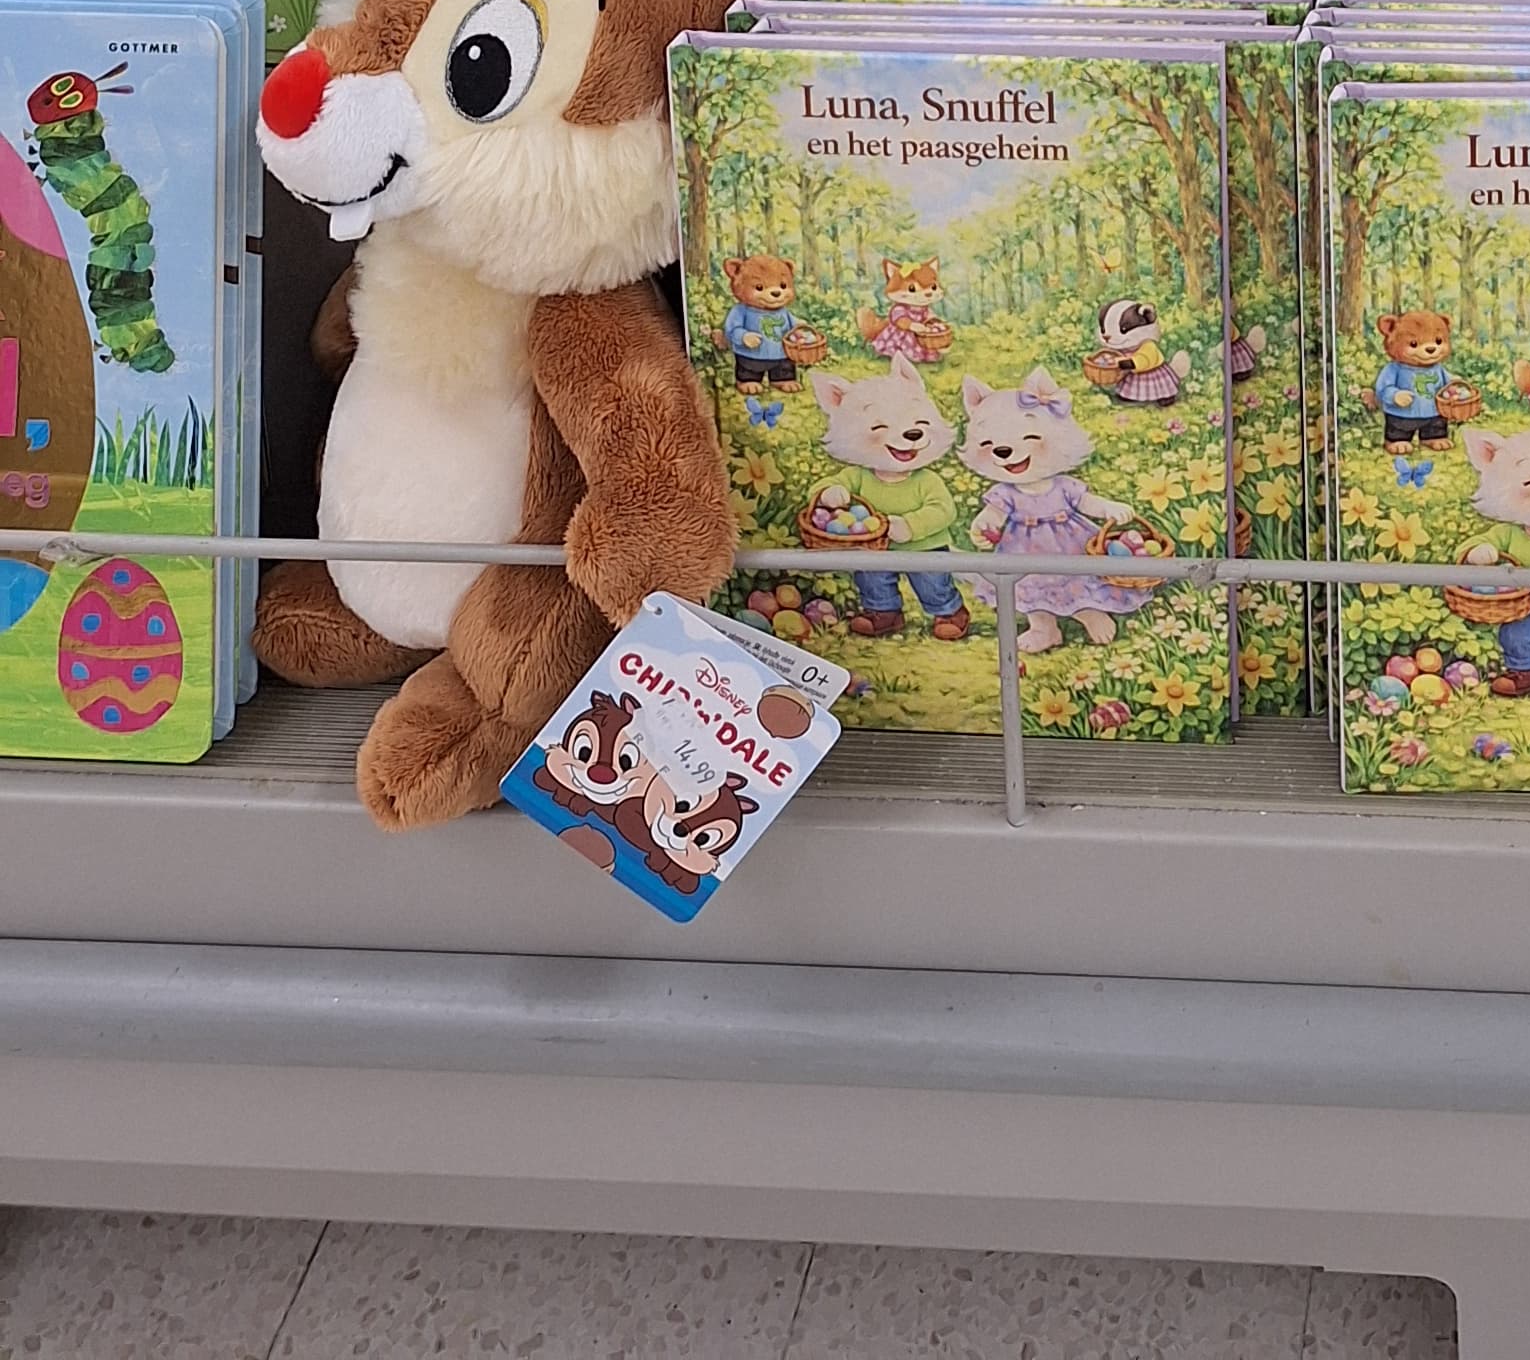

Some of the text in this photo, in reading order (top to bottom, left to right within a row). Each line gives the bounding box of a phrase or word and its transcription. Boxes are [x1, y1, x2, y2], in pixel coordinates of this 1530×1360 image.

[108, 42, 179, 54] GOTTMER
[801, 84, 1057, 128] Luna, Snuffel
[806, 131, 1070, 166] en het paasgeheim
[1470, 185, 1505, 207] en
[801, 666, 829, 688] 0+
[672, 738, 717, 785] 14.99
[714, 721, 794, 787] DALE
